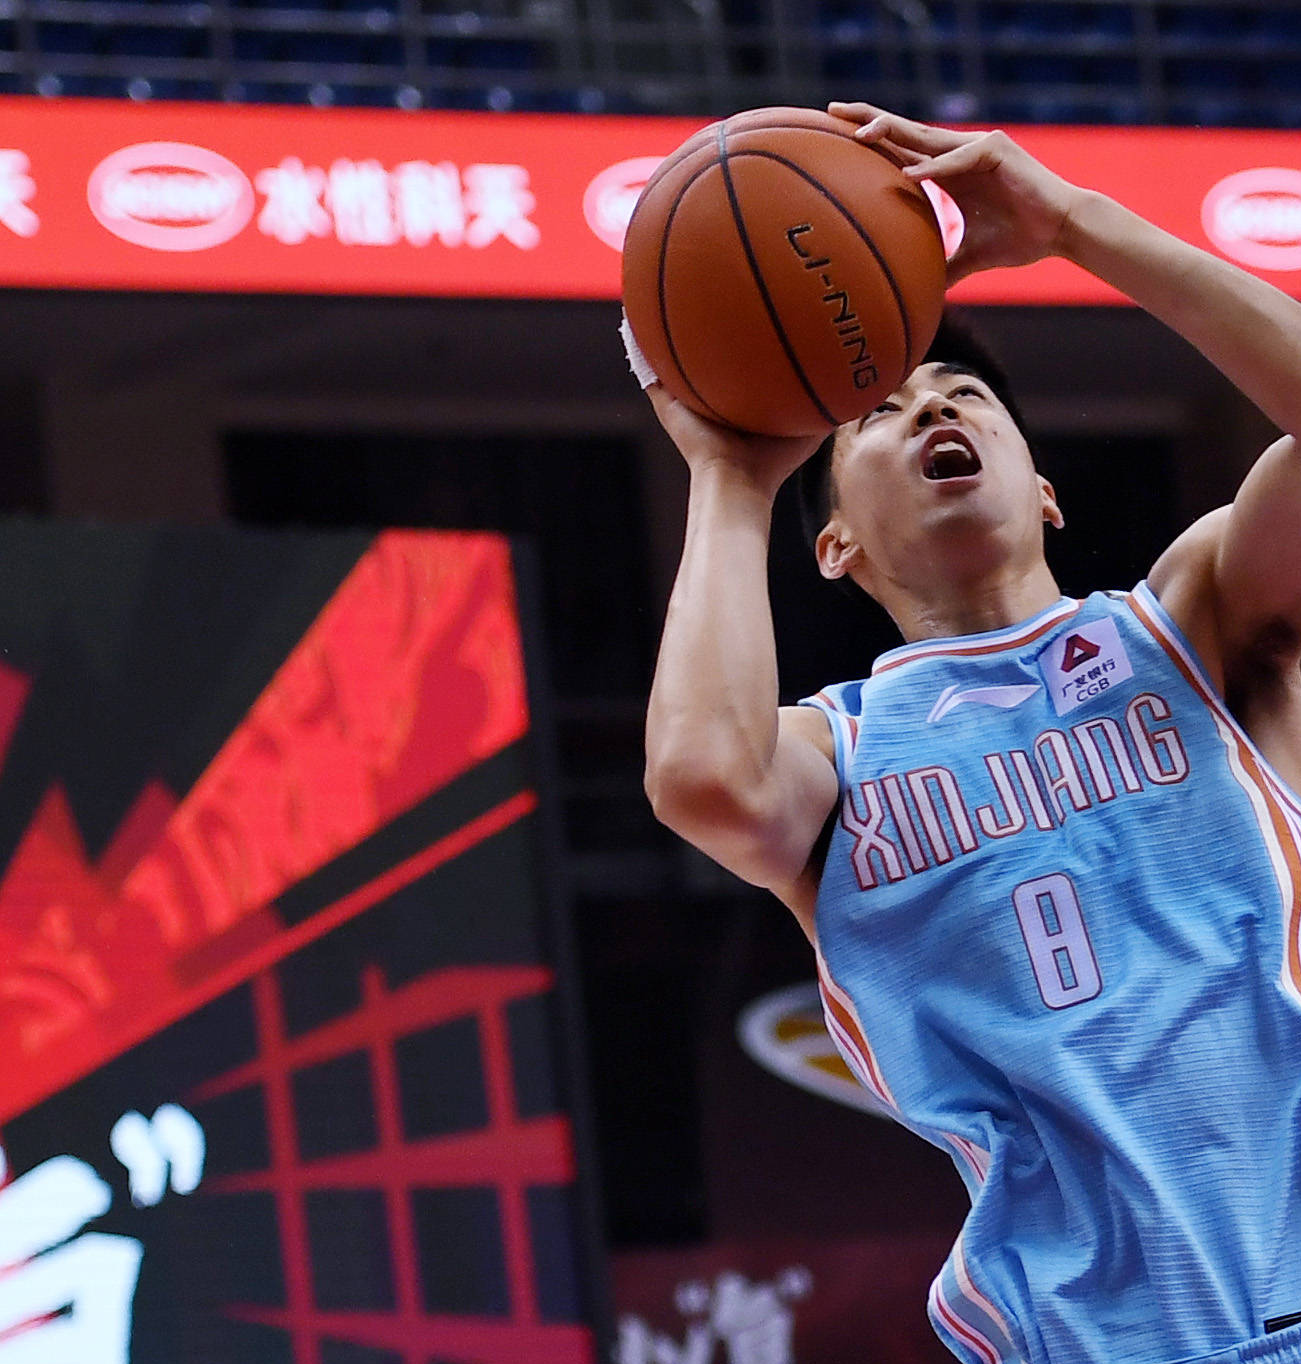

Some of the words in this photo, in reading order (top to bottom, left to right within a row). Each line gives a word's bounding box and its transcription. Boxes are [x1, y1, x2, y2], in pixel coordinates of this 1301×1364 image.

[785, 223, 880, 390] LI-NING
[1076, 677, 1111, 702] CGB
[842, 692, 1190, 891] XINJIANG
[1011, 872, 1103, 1010] 8
